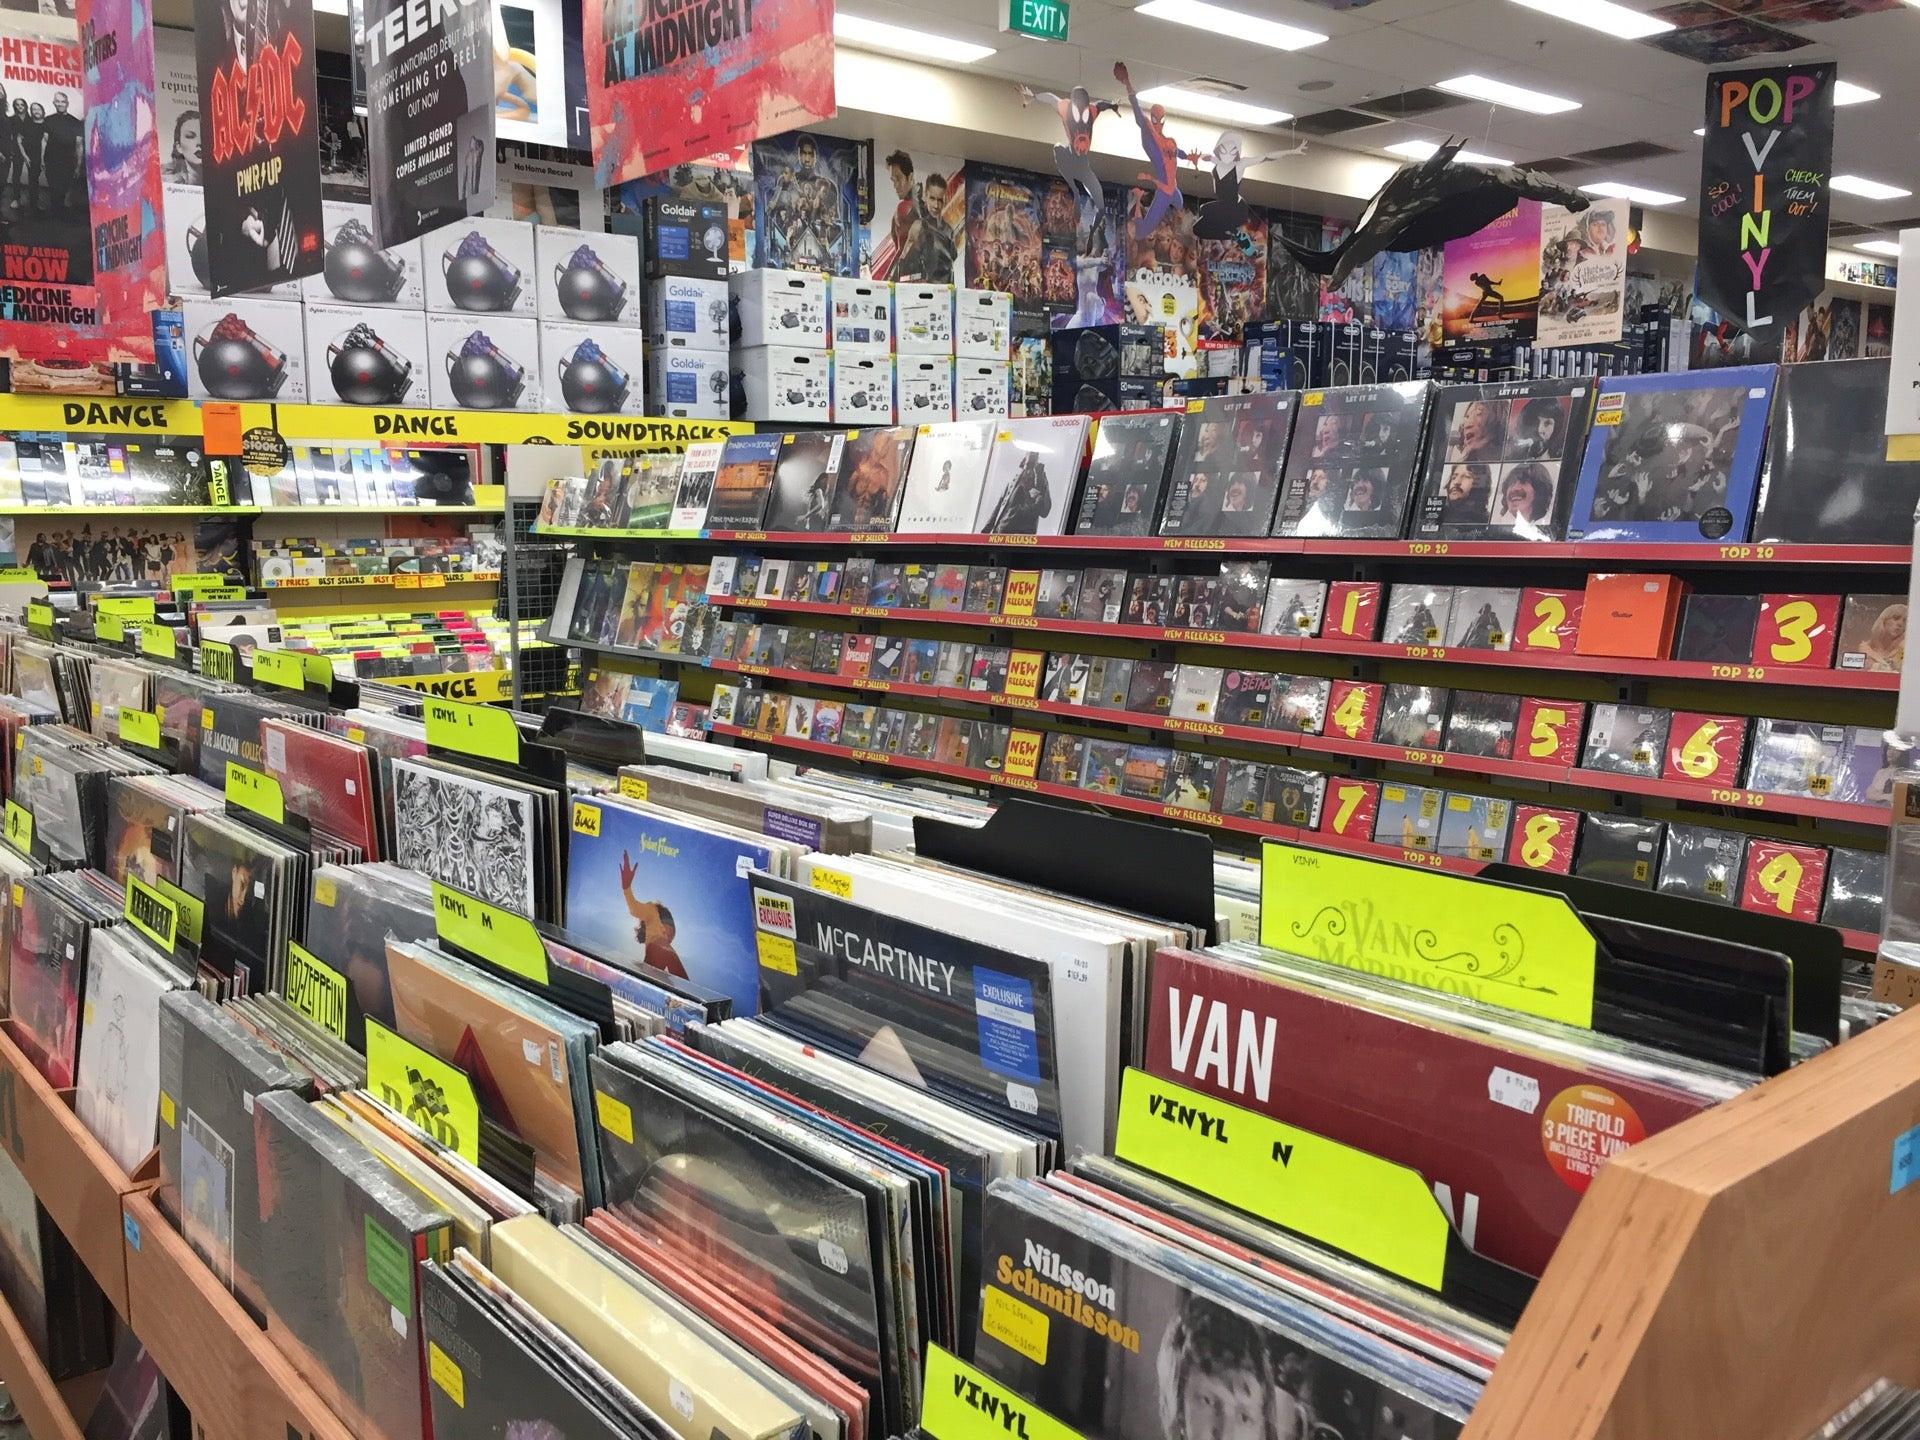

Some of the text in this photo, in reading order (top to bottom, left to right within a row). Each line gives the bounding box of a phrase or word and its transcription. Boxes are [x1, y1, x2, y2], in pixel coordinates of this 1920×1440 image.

[1022, 1, 1057, 33] EXIT
[0, 37, 83, 72] HTERS
[435, 60, 448, 80] TO
[408, 89, 440, 118] OUT NOW
[404, 122, 453, 157] LIMITED SIGNED
[396, 158, 416, 179] COPIES
[514, 163, 573, 178] No Home Record
[1785, 169, 1824, 187] CHECK
[1783, 187, 1815, 203] THEM
[661, 203, 697, 217] Goldair
[1788, 201, 1818, 218] OUT!
[1740, 130, 1781, 327] VINYL
[5, 257, 69, 282] NOW
[0, 286, 73, 307] EDICINE
[669, 285, 705, 298] Goldair
[13, 304, 96, 325] MIDNIGH
[671, 358, 706, 371] Goldair
[63, 403, 168, 427] DANCE
[374, 414, 458, 436] DANCE
[567, 420, 731, 442] SOUNDTRACKS
[211, 463, 227, 503] DANCE
[1409, 543, 1448, 554] TOP 20
[1720, 546, 1774, 559] TOP 20
[319, 576, 365, 585] BEST SELLERS
[1009, 581, 1035, 595] NEW
[1007, 597, 1032, 607] RELEASE
[1341, 590, 1359, 635] 1
[1527, 597, 1566, 649] 2
[1771, 601, 1818, 662] 3
[1406, 646, 1445, 658] TOP 20
[1010, 661, 1038, 675] NEW
[1711, 665, 1764, 679] TOP 20
[396, 678, 477, 698] ANCE
[1008, 677, 1035, 688] RELEASE
[432, 707, 457, 723] VINYL
[1334, 688, 1366, 738] 4
[1529, 707, 1566, 757] 5
[203, 730, 239, 756] JOE JACKSON
[1010, 739, 1037, 756] NEW
[1681, 720, 1720, 778] 6
[1008, 756, 1034, 768] RELEASE
[1405, 750, 1444, 764] TOP 20
[1711, 789, 1764, 806] TOP 20
[1333, 785, 1366, 835] 7
[1521, 814, 1560, 868] 8
[1403, 851, 1442, 866] TOP 20
[1758, 852, 1803, 914] 9
[440, 893, 493, 930] VINYL M
[760, 897, 770, 906] JB
[759, 908, 793, 929] EXCLUSIVE
[982, 984, 1024, 1008] EXCLUSIVE
[1169, 986, 1277, 1103] VAN
[1567, 1103, 1625, 1137] TRIFOLD
[1149, 1094, 1293, 1168] VINYL N
[1545, 1119, 1554, 1139] 3
[1557, 1124, 1597, 1151] PIECE
[1549, 1141, 1588, 1162] INCLUDES
[1566, 1159, 1591, 1176] LYRIC
[1024, 1238, 1117, 1312] Nilsson
[997, 1255, 1141, 1353] Schmilsson
[954, 1373, 1030, 1440] VINYL
